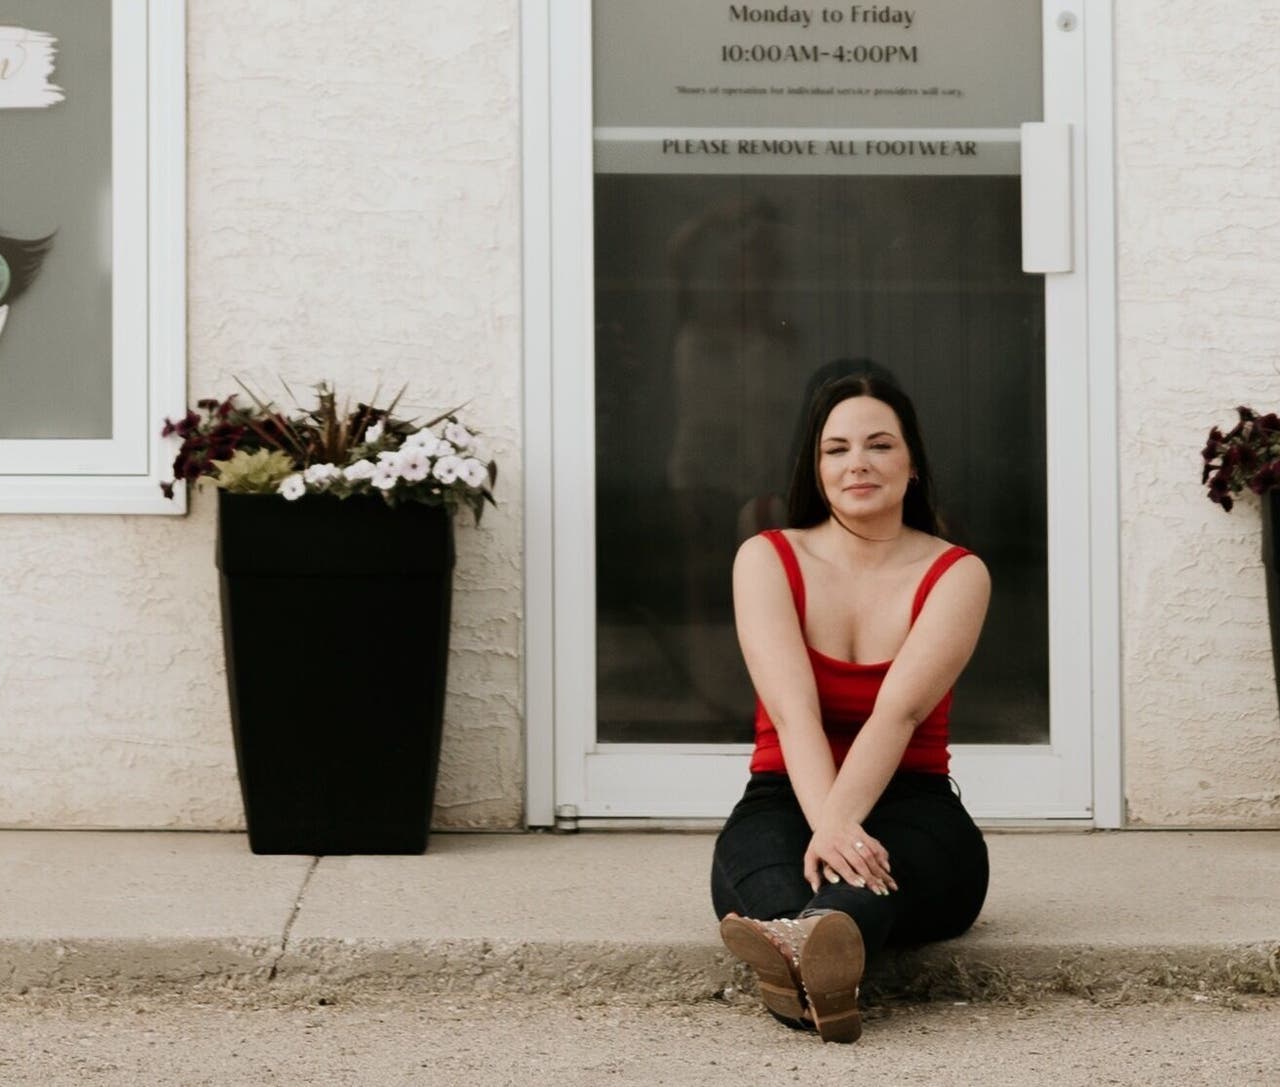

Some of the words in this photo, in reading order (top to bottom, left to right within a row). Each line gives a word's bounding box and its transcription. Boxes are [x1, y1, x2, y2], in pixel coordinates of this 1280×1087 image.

[728, 5, 811, 28] Monday
[822, 7, 843, 23] to
[851, 6, 915, 29] Friday
[720, 45, 919, 63] 10:00AM-4:00PM
[662, 138, 729, 155] PLEASE
[737, 139, 817, 155] REMOVE
[824, 140, 857, 156] ALL
[865, 140, 977, 157] FOOTWEAR
